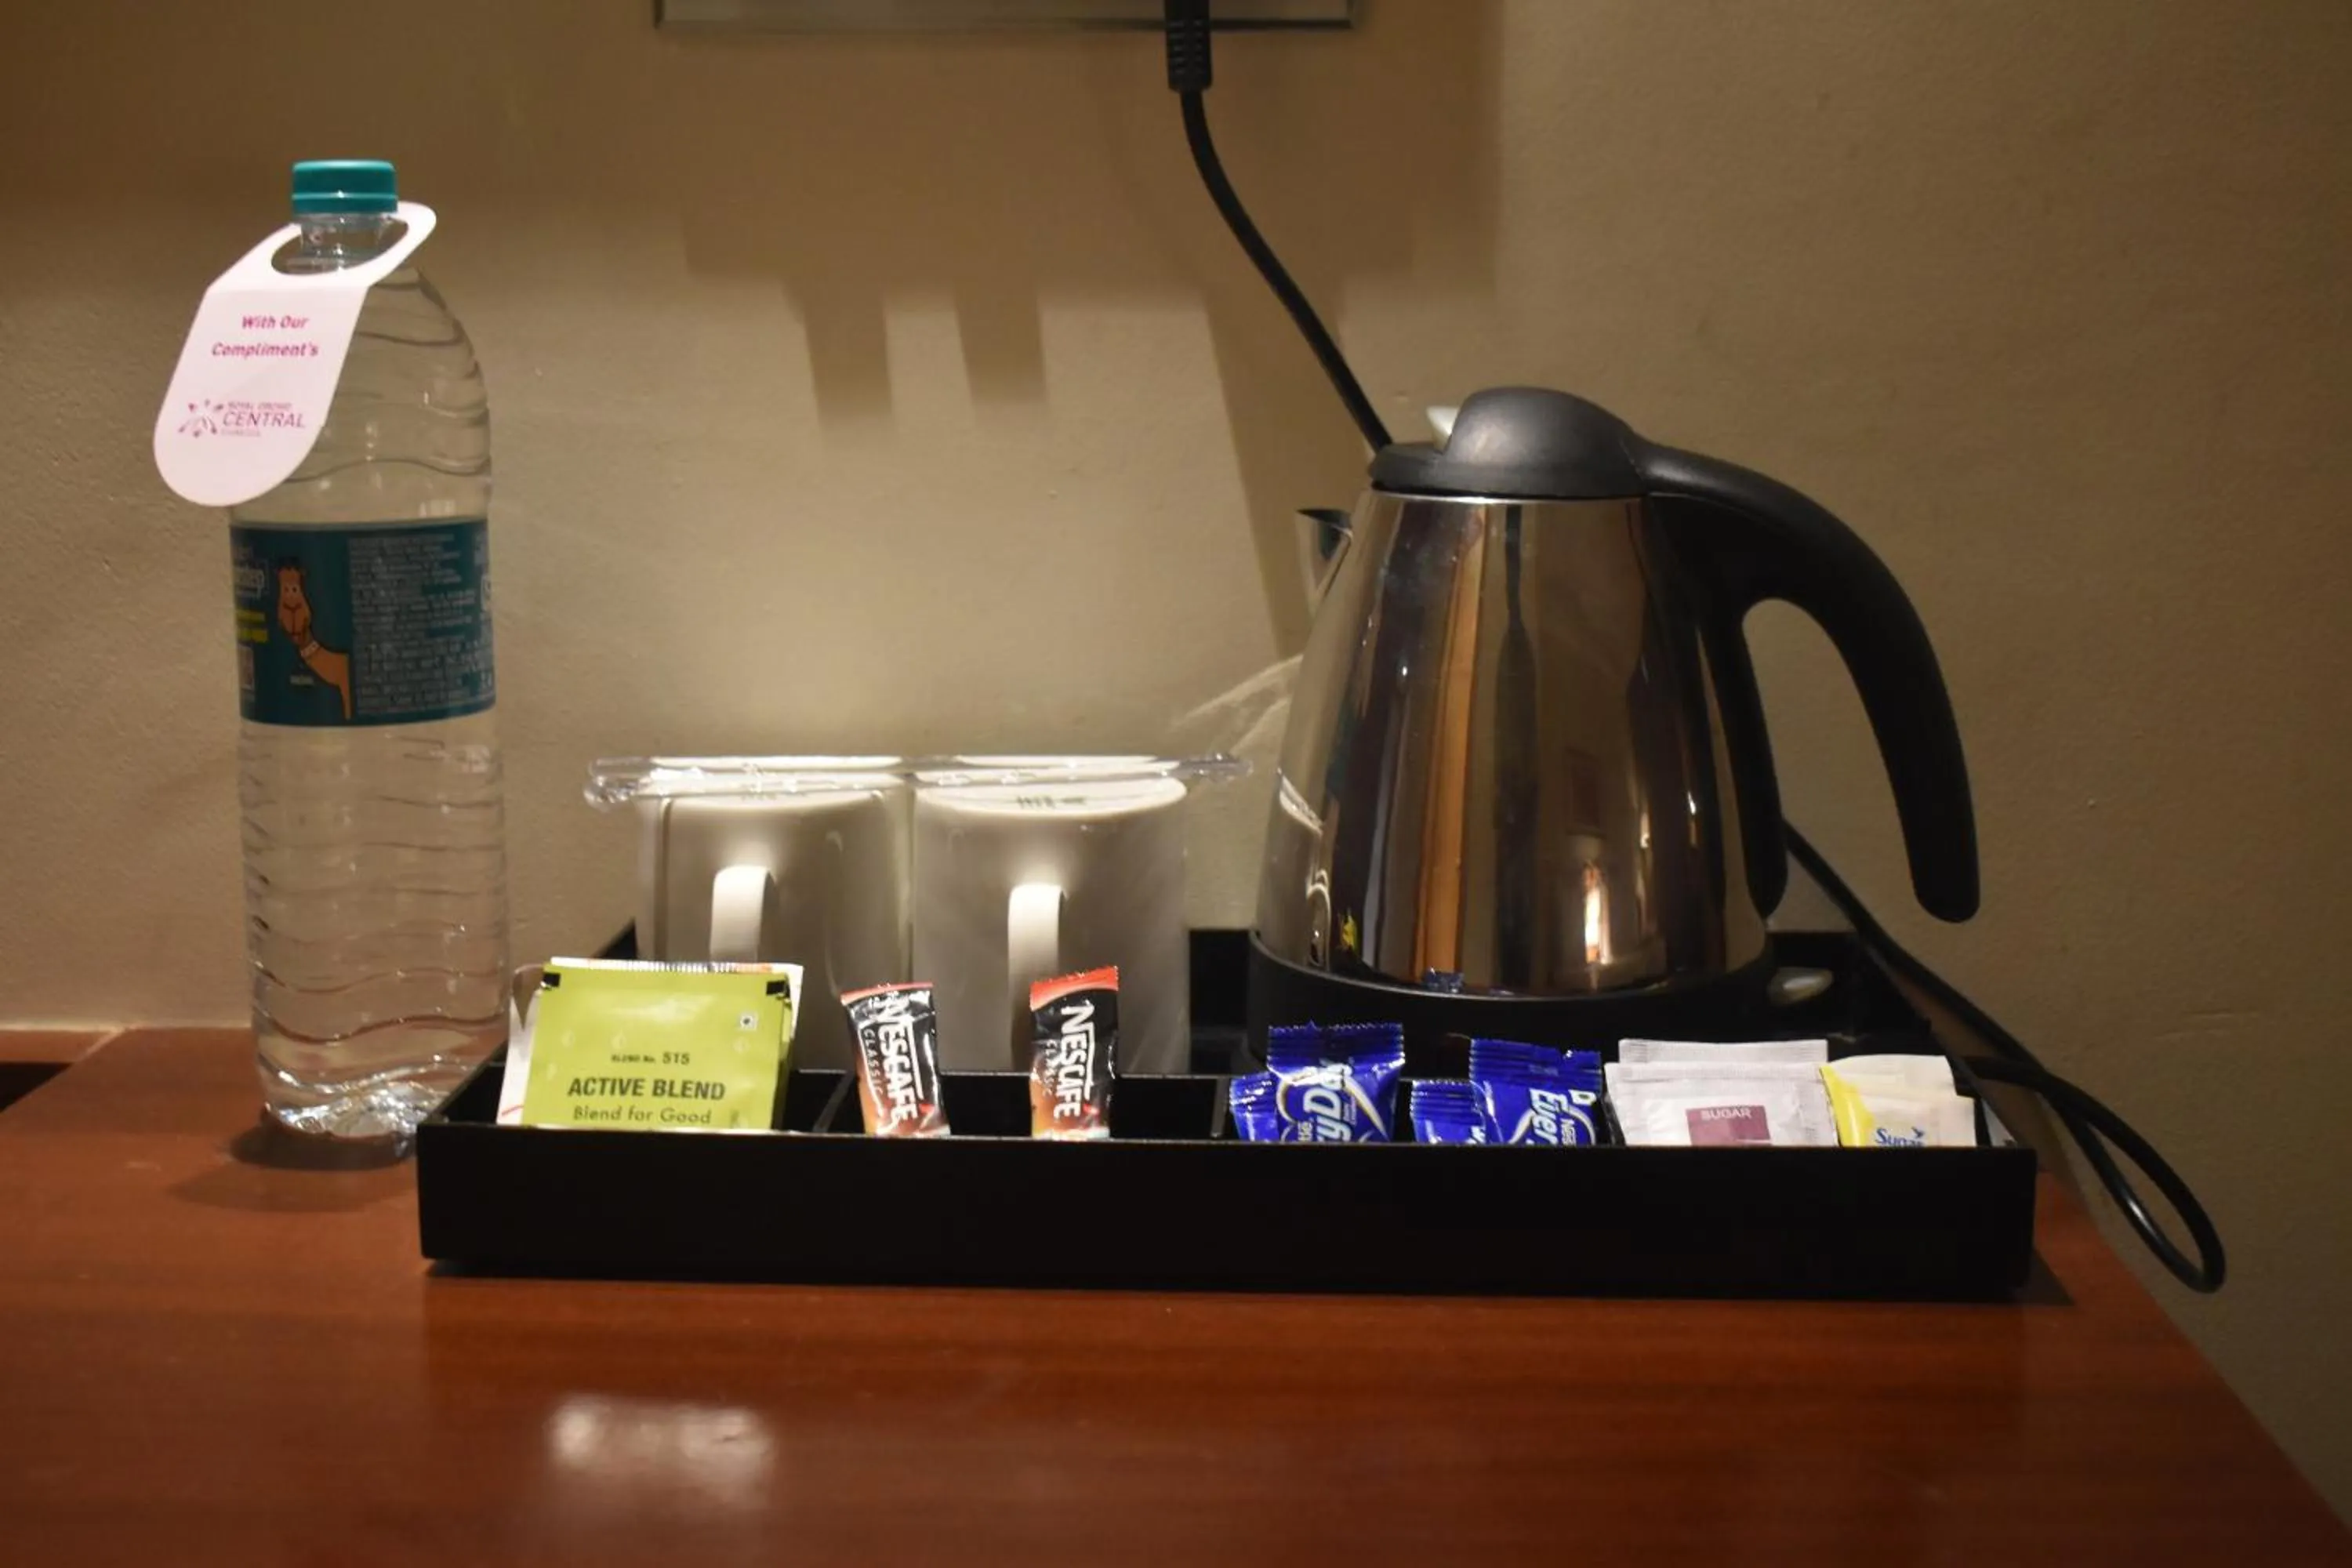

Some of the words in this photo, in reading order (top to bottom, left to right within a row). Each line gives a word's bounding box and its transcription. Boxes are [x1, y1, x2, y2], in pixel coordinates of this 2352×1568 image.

[242, 314, 276, 328] With
[280, 315, 310, 328] Our
[212, 342, 318, 359] Compliment's
[223, 412, 305, 428] CENTRAL
[662, 1051, 691, 1065] 515
[863, 1028, 884, 1096] CLASSIC
[568, 1077, 644, 1098] ACTIVE
[652, 1079, 726, 1101] BLEND
[573, 1105, 622, 1122] Blend
[627, 1105, 653, 1123] for
[660, 1107, 712, 1124] Good
[1700, 1108, 1753, 1121] SUGAR
